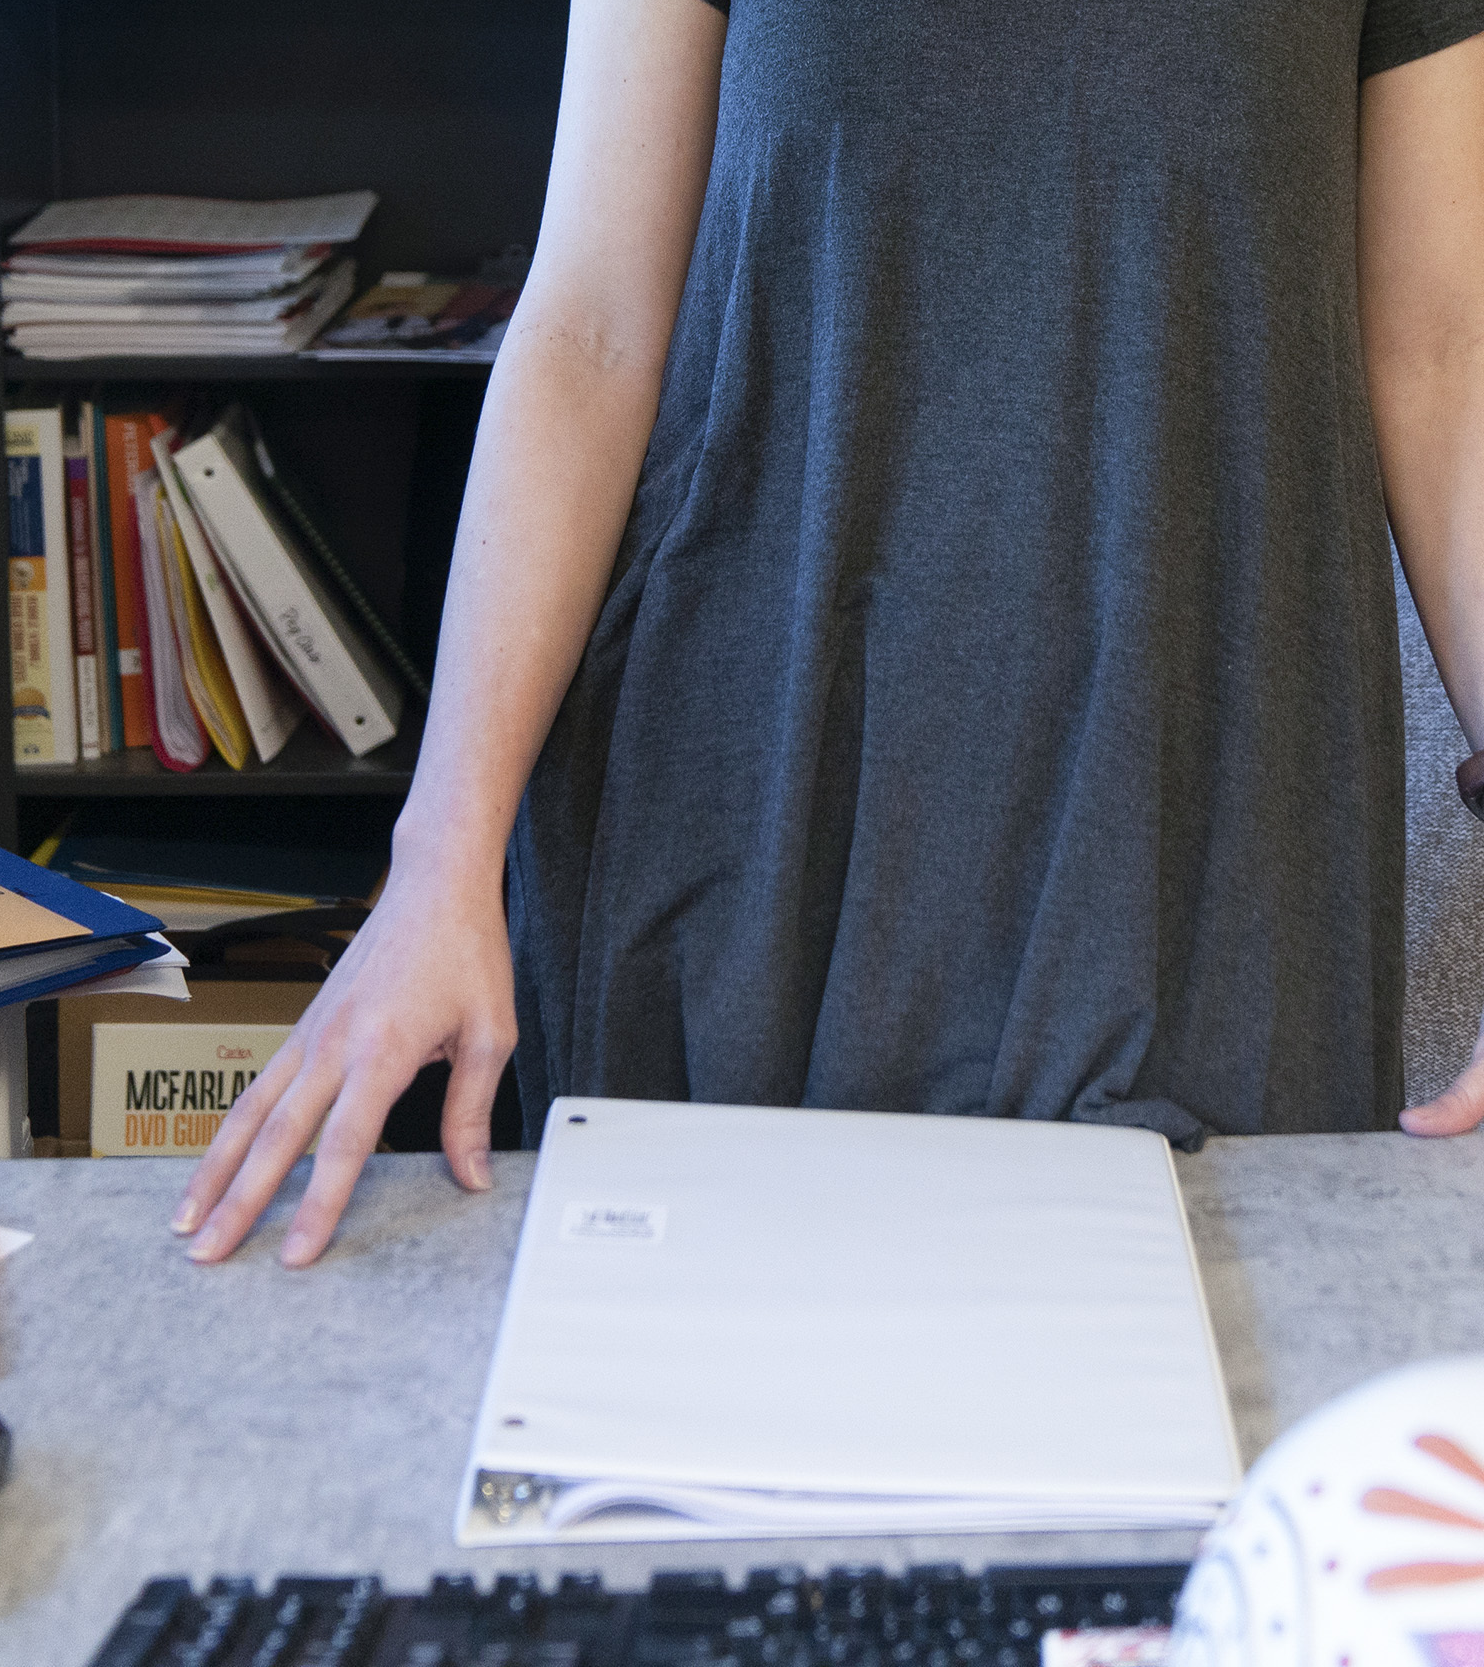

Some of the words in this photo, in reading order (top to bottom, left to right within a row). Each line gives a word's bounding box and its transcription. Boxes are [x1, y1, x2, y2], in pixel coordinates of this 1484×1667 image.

[126, 1069, 264, 1110] MCFARLA
[125, 1113, 167, 1147] DVD
[173, 1113, 227, 1147] GUID
